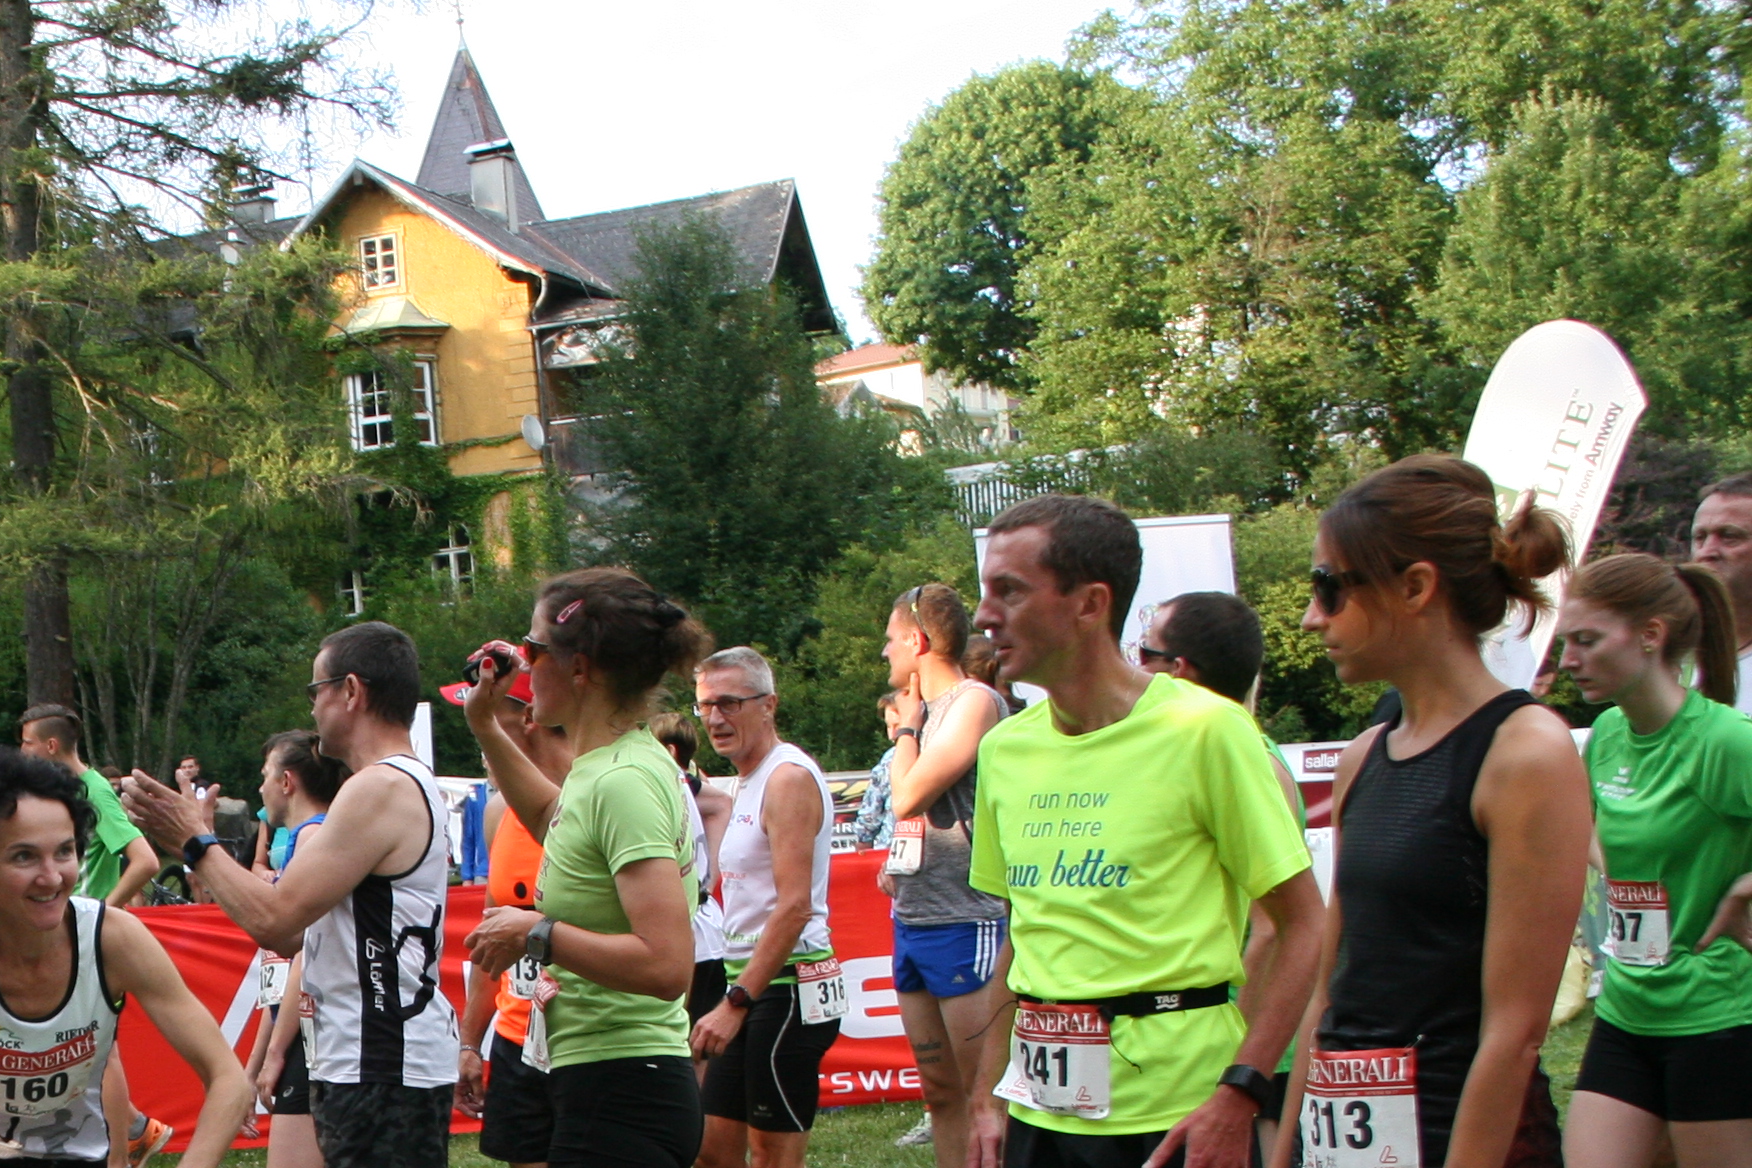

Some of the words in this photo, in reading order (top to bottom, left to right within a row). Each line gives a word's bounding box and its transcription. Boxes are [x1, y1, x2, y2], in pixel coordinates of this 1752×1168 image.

[1584, 401, 1624, 468] Amway
[1029, 793, 1060, 809] run
[1066, 792, 1109, 808] now
[1022, 821, 1052, 838] run
[1058, 818, 1102, 837] here
[1050, 848, 1131, 888] better
[817, 977, 845, 1005] 316
[2, 1037, 95, 1071] GENERALI
[1020, 1041, 1068, 1087] 241
[0, 1071, 69, 1103] 160
[1309, 1098, 1374, 1150] 313
